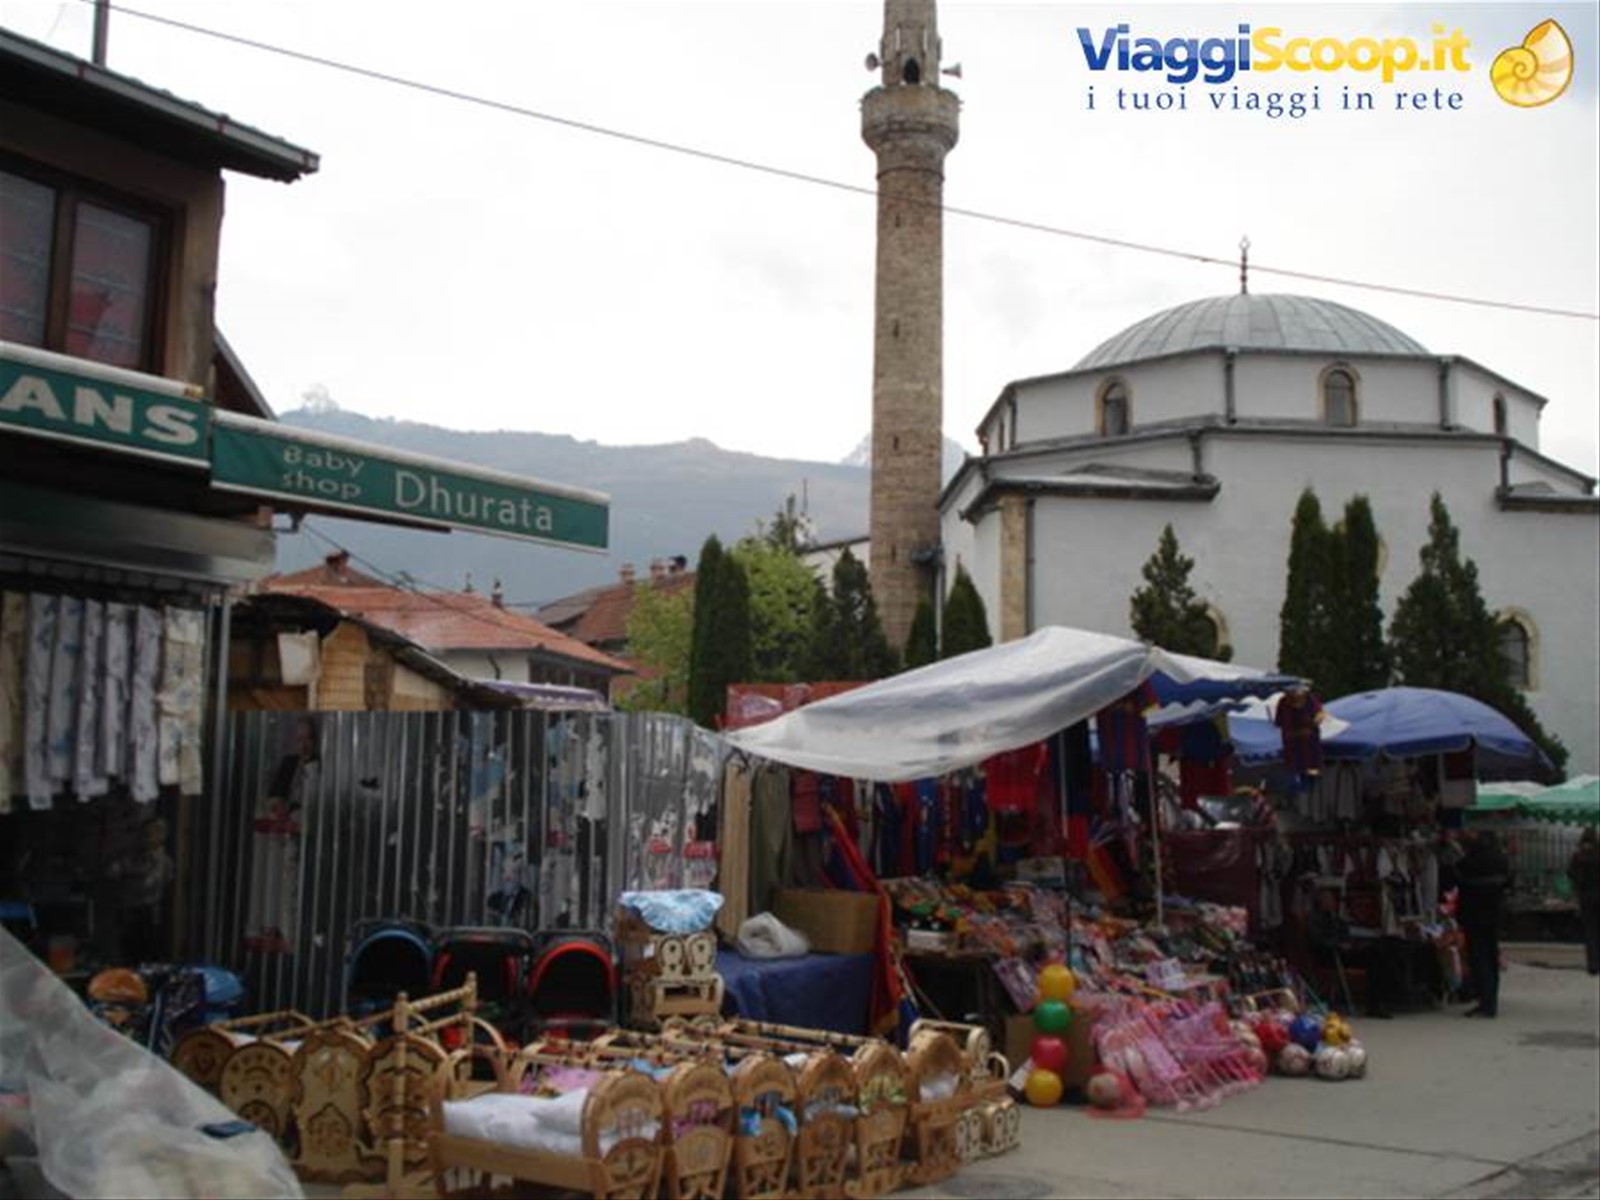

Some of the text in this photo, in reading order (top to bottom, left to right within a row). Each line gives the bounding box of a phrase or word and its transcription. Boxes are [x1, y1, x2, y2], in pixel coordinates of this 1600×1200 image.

[0, 374, 198, 445] ANS
[282, 445, 365, 477] Baby
[282, 470, 363, 499] shop
[394, 470, 553, 532] Dhurata
